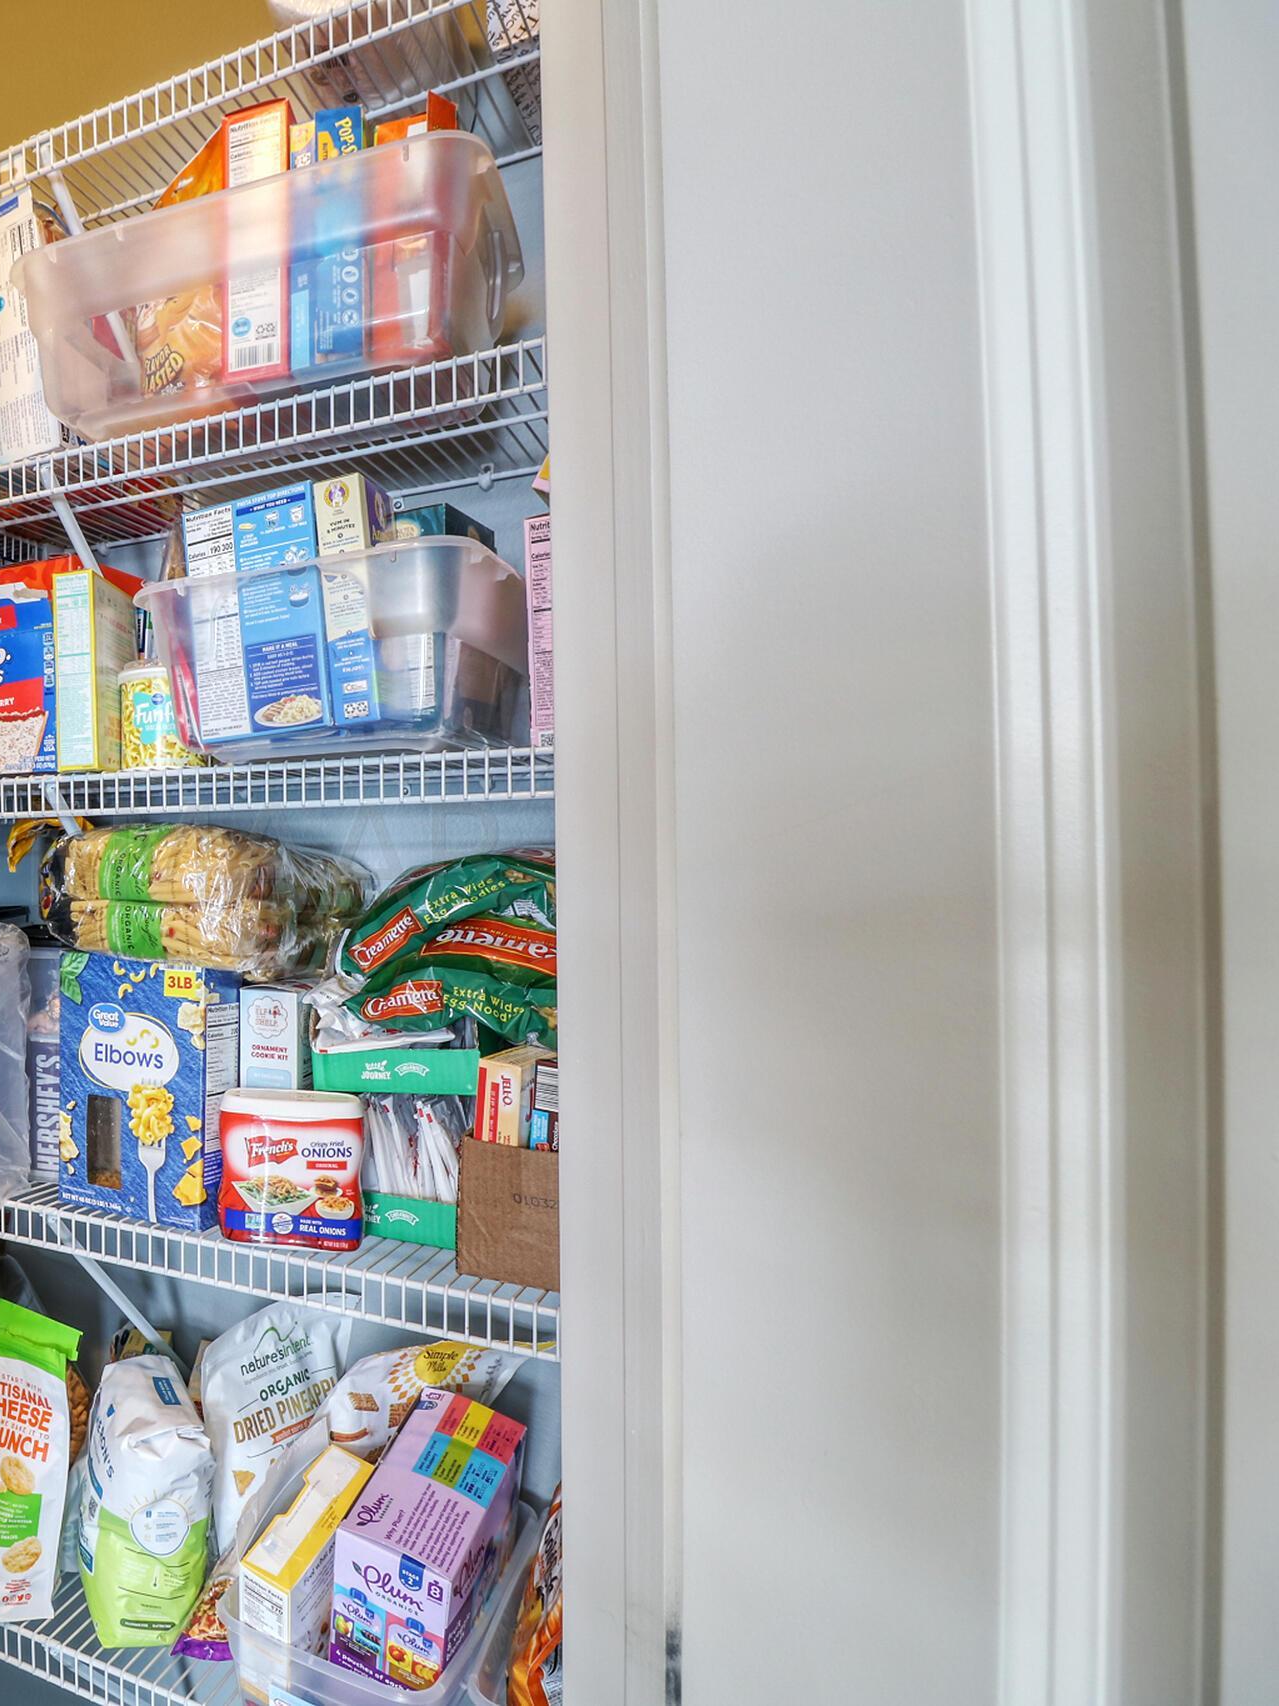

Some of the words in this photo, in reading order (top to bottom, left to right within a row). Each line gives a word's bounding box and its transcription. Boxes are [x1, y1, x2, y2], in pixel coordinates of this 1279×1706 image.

[427, 891, 459, 913] Extra
[465, 878, 494, 896] Wide
[125, 905, 134, 950] ORGANIC
[354, 913, 414, 966] Creamette
[168, 976, 193, 989] 3LB
[453, 987, 487, 1001] Extra
[92, 1009, 119, 1023] Great
[98, 1018, 120, 1028] Value
[94, 1042, 164, 1069] Elbows
[251, 1044, 288, 1054] ORNAMENT
[251, 1051, 275, 1060] COOKIE
[276, 1053, 288, 1061] KIT
[361, 1070, 392, 1080] JOURNEY
[36, 1054, 60, 1177] HERSHEY'S
[249, 1140, 294, 1158] French's
[301, 1145, 353, 1159] ONIONS
[310, 1141, 328, 1150] Crispy
[329, 1140, 344, 1148] Fried
[299, 1224, 318, 1234] REAL
[319, 1226, 346, 1236] ONIONS
[424, 1350, 458, 1361] Simple
[259, 1368, 311, 1402] ORGANIC
[233, 1406, 276, 1444] DRIED
[357, 1493, 390, 1524] Plum
[408, 1577, 414, 1585] 2
[364, 1565, 424, 1612] Plum
[430, 1585, 440, 1598] 8
[375, 1592, 419, 1616] ORGANICS
[342, 1654, 373, 1677] pouches
